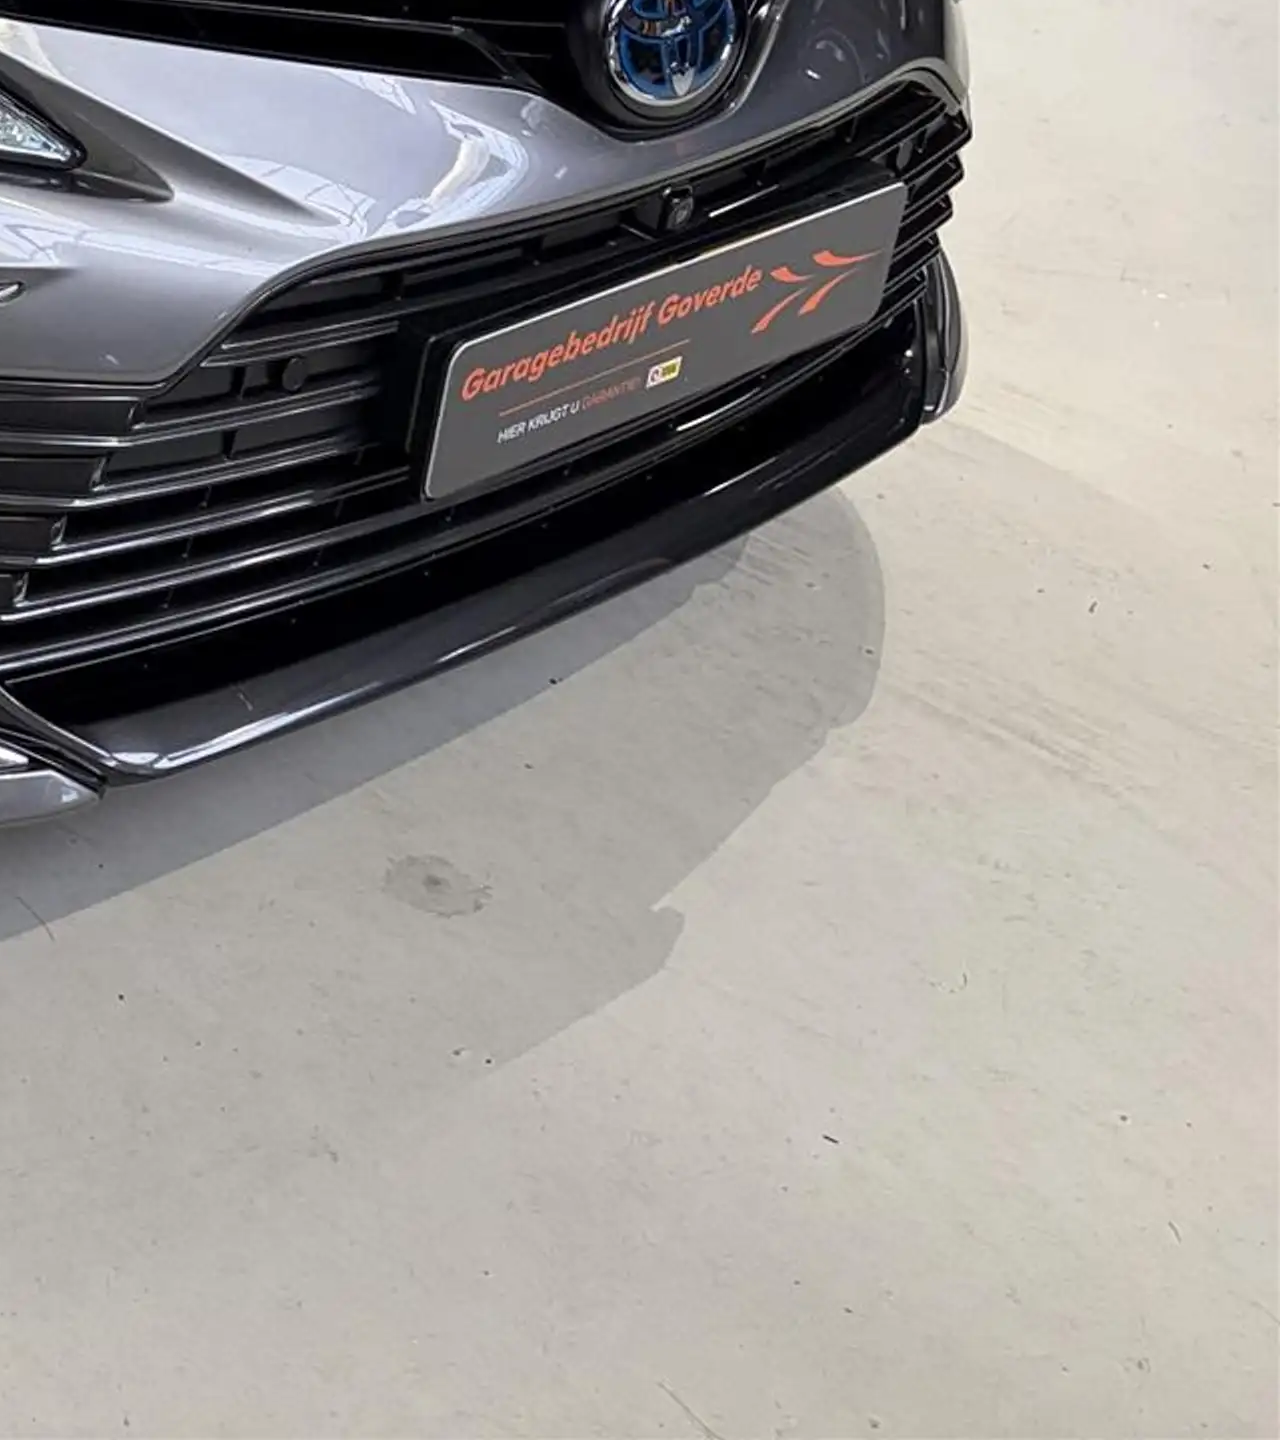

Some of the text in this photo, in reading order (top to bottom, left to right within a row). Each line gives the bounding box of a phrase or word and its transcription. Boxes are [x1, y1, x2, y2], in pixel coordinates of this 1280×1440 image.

[461, 265, 762, 401] Garagebedrijf Goverde
[497, 421, 527, 443] HIER
